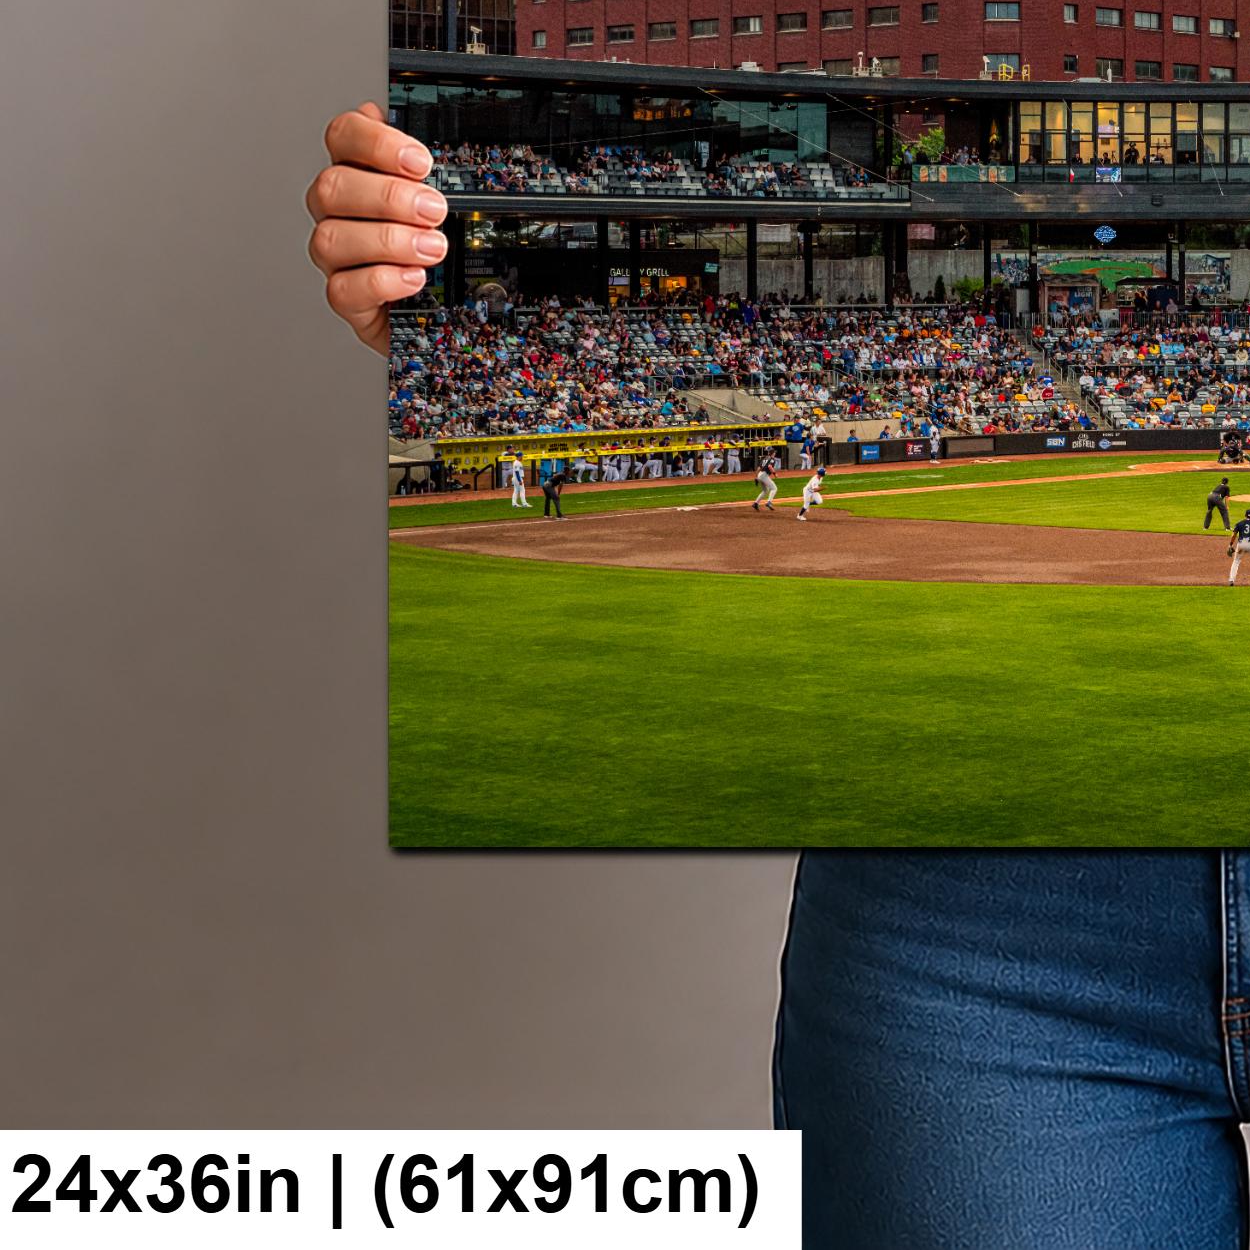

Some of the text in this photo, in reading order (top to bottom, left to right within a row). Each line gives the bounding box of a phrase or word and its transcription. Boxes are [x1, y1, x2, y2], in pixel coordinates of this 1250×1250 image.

[610, 267, 670, 277] GALLY GRILL
[1243, 524, 1250, 534] 3
